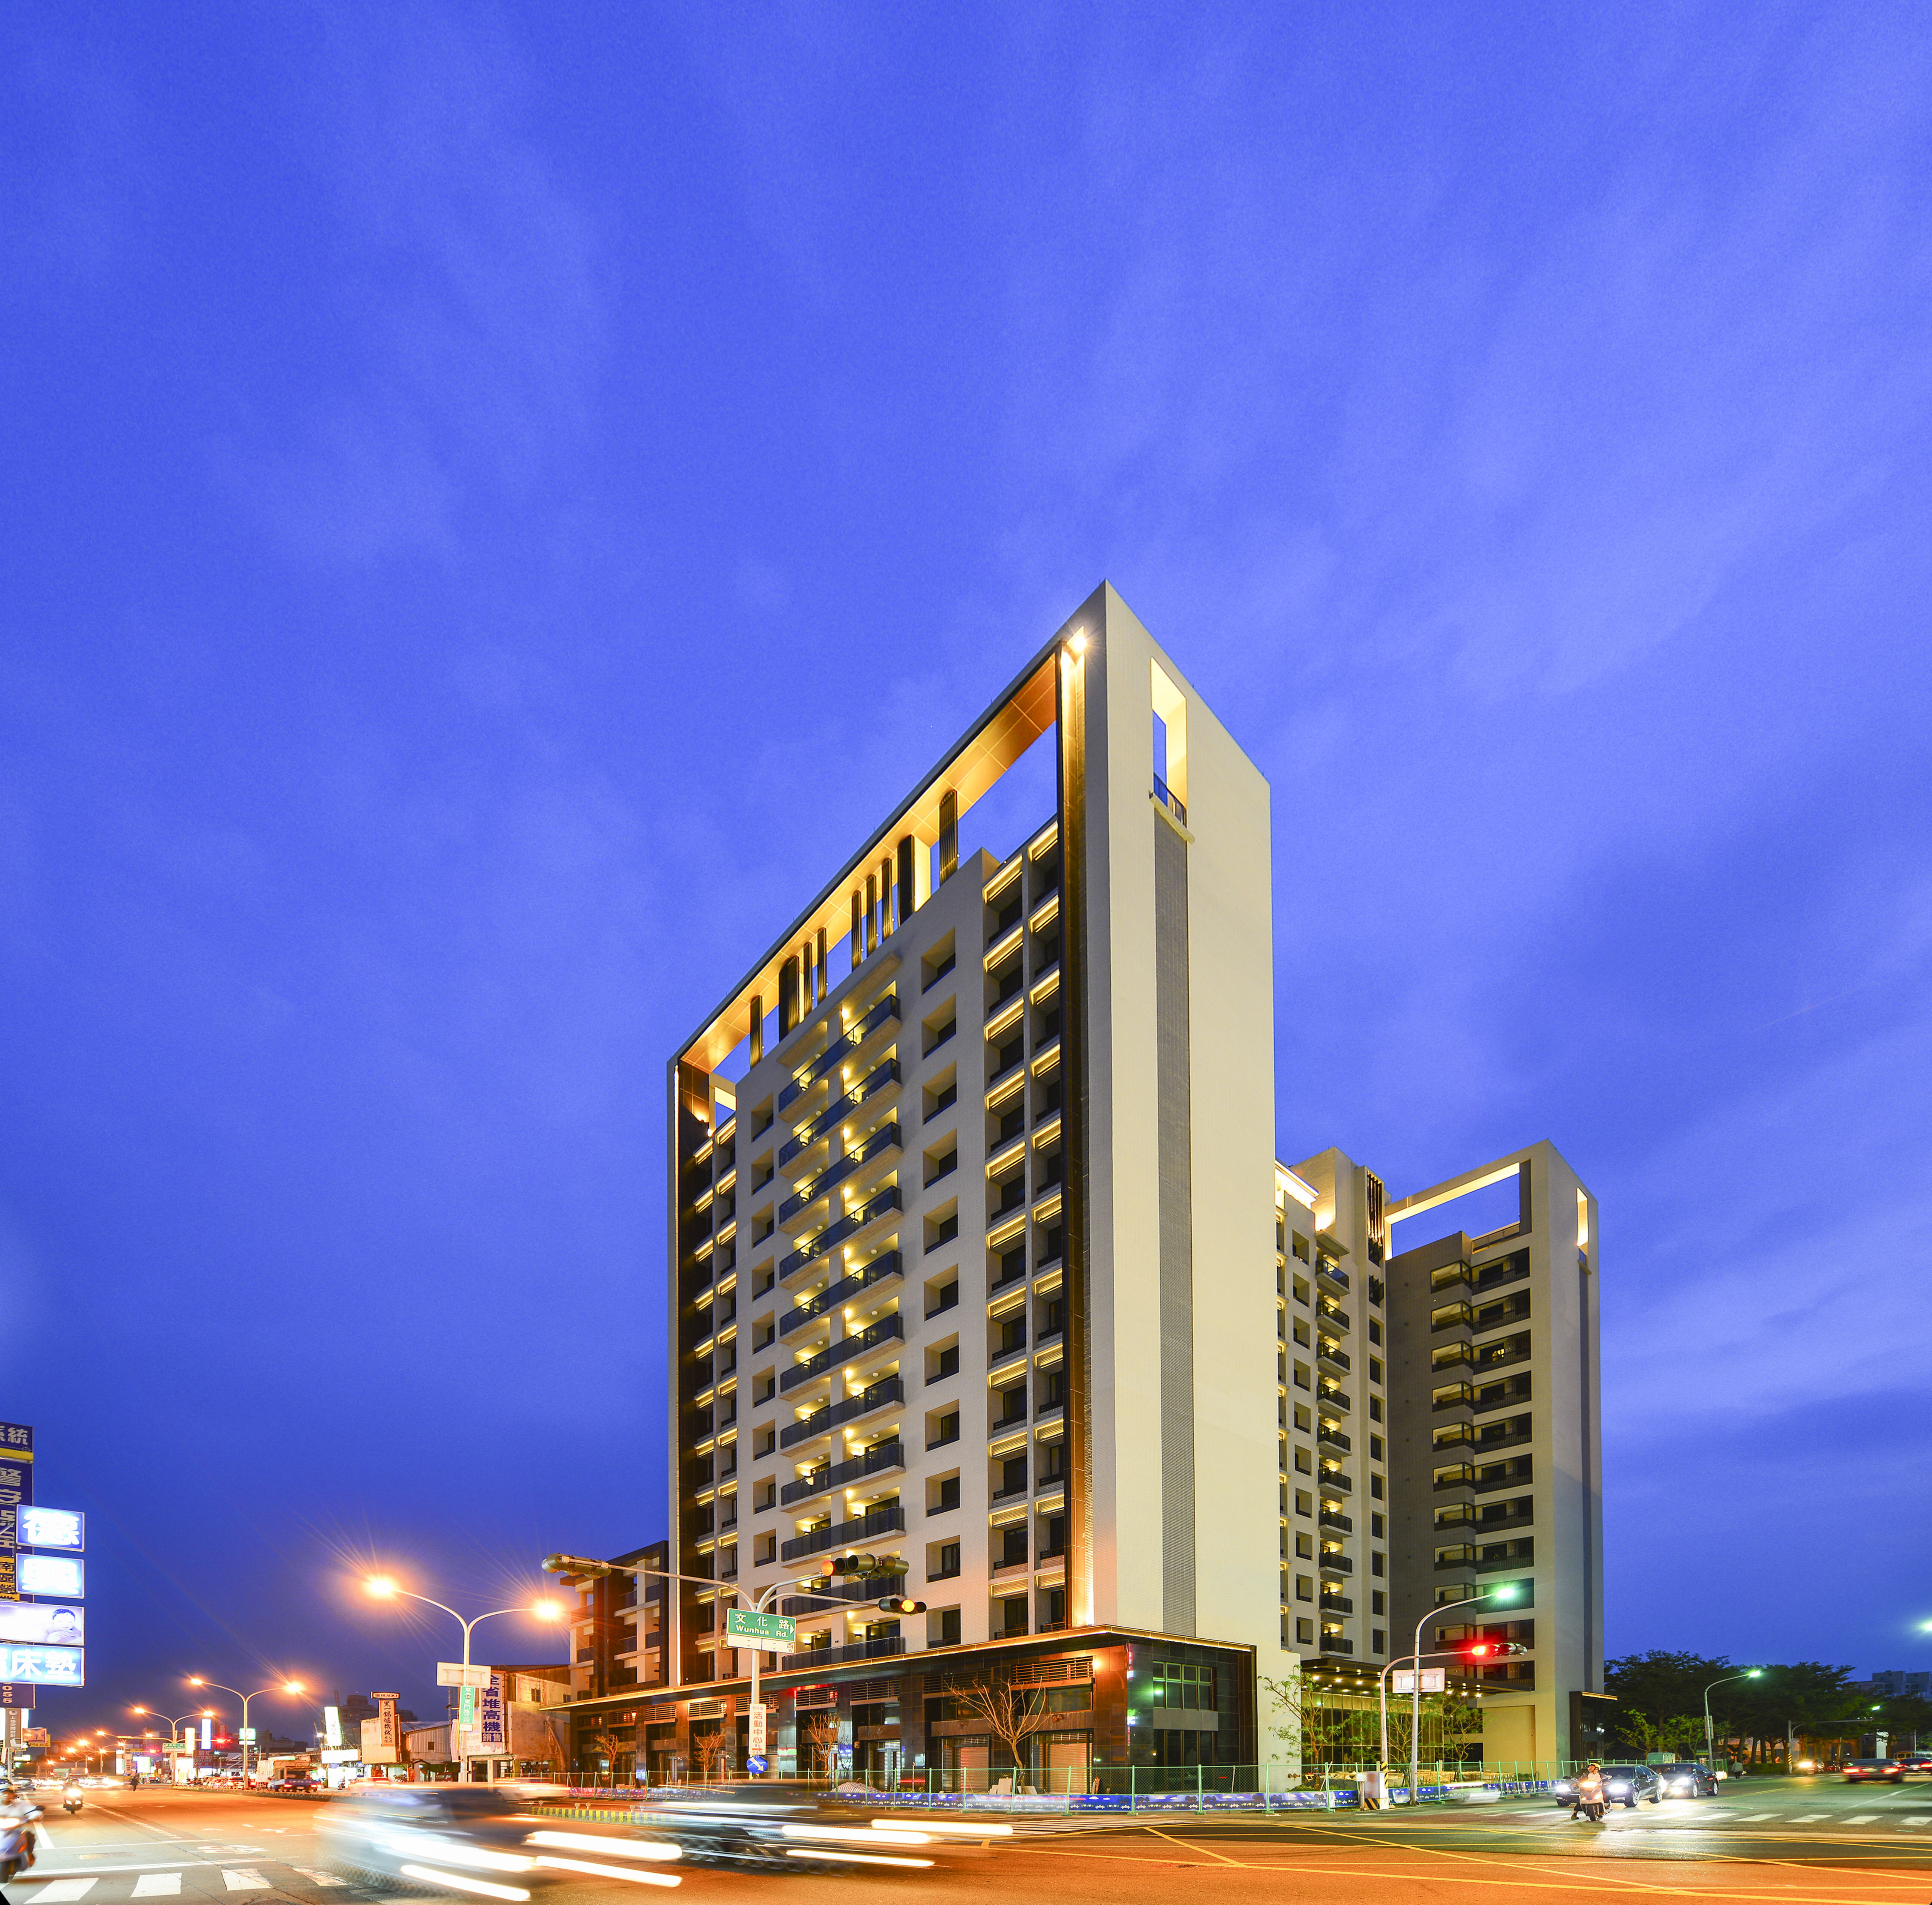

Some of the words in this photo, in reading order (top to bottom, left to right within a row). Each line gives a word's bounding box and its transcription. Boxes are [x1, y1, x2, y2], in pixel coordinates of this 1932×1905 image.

[0, 1426, 27, 1445] 統
[735, 1613, 790, 1630] 文化路
[736, 1625, 769, 1635] Wunhua
[0, 1648, 76, 1680] 床墊
[2, 1683, 13, 1703] 055
[482, 1733, 501, 1742] 銷售
[753, 1712, 762, 1744] 活動中心
